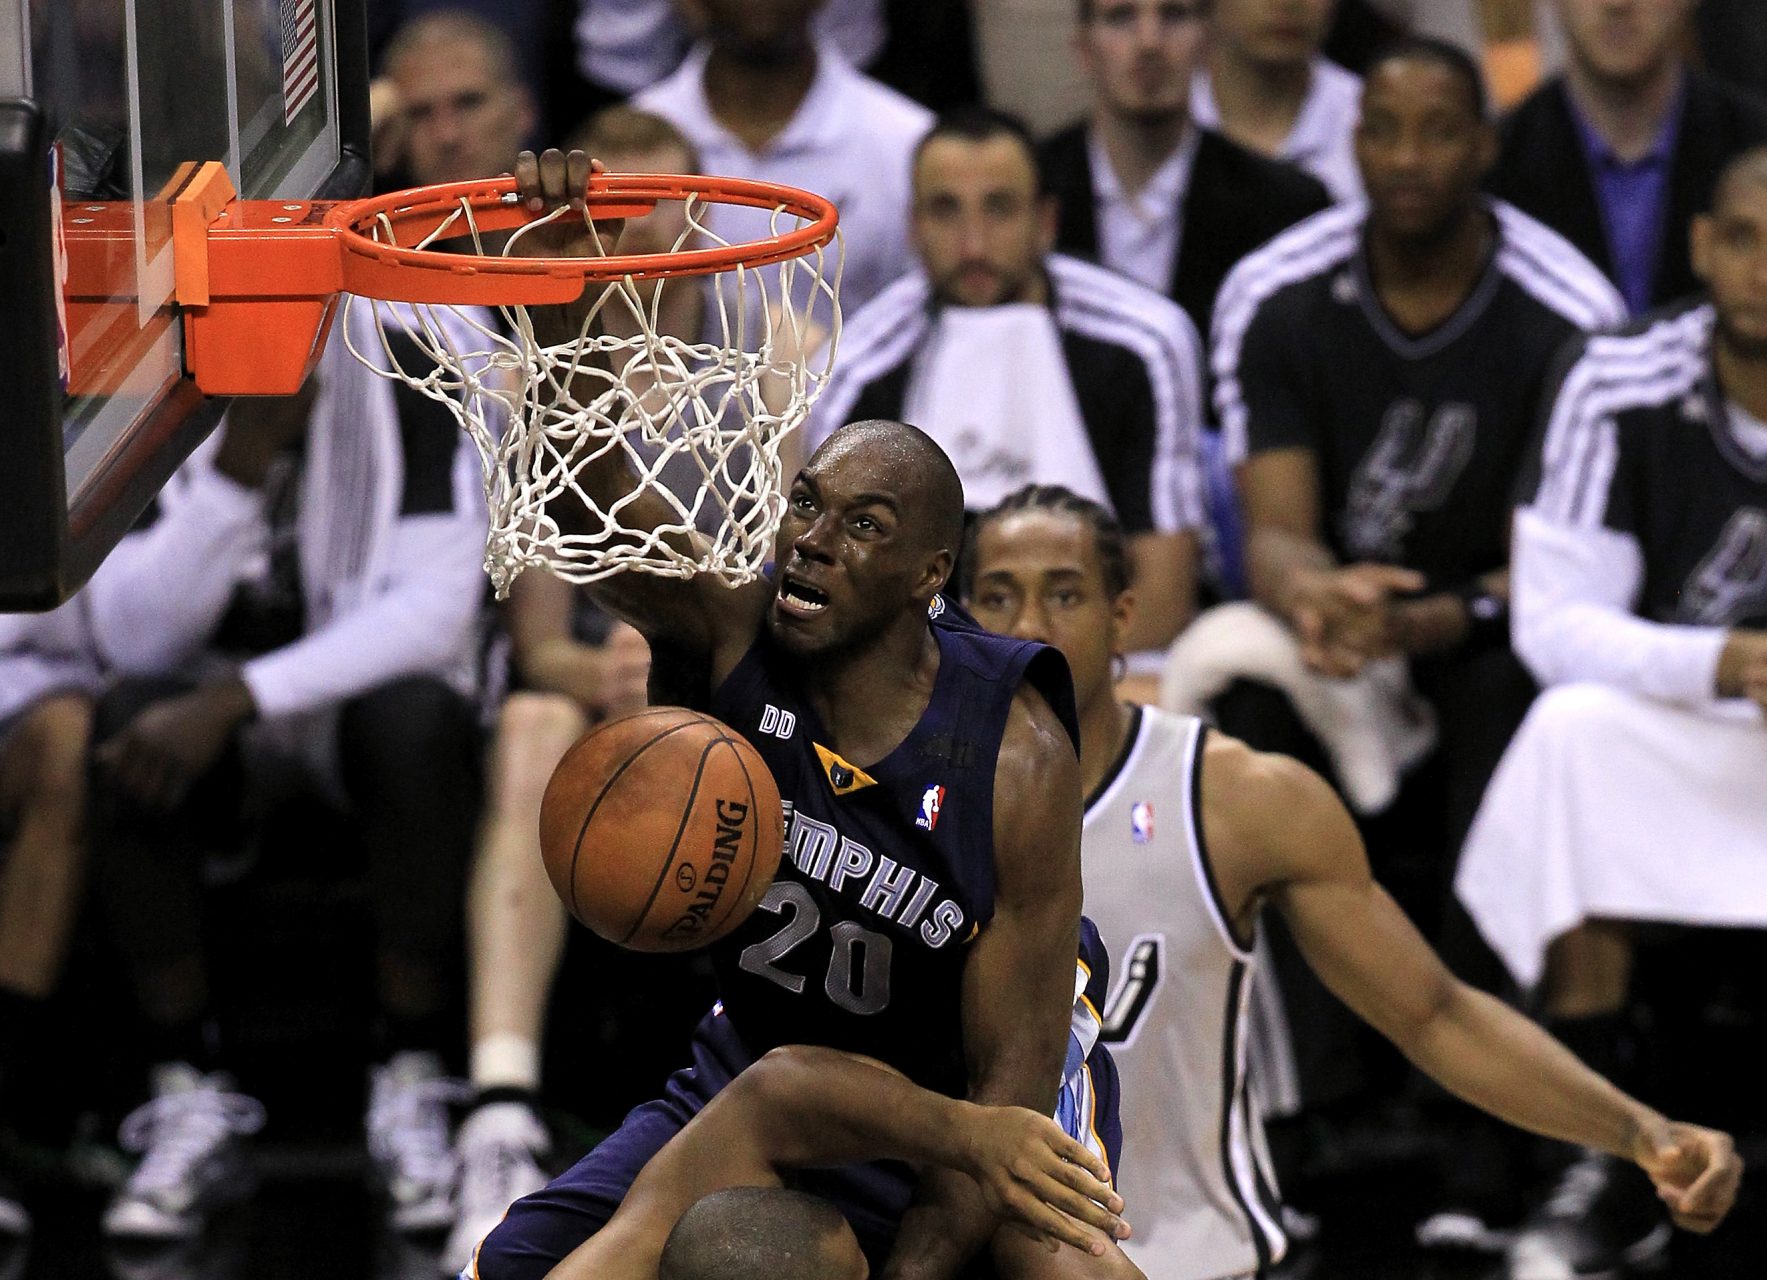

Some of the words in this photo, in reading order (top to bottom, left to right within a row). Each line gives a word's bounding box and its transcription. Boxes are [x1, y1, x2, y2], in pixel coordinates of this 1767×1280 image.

[758, 703, 796, 740] DD
[915, 817, 929, 828] NBA
[661, 798, 749, 940] PALDING
[738, 881, 893, 1016] 20
